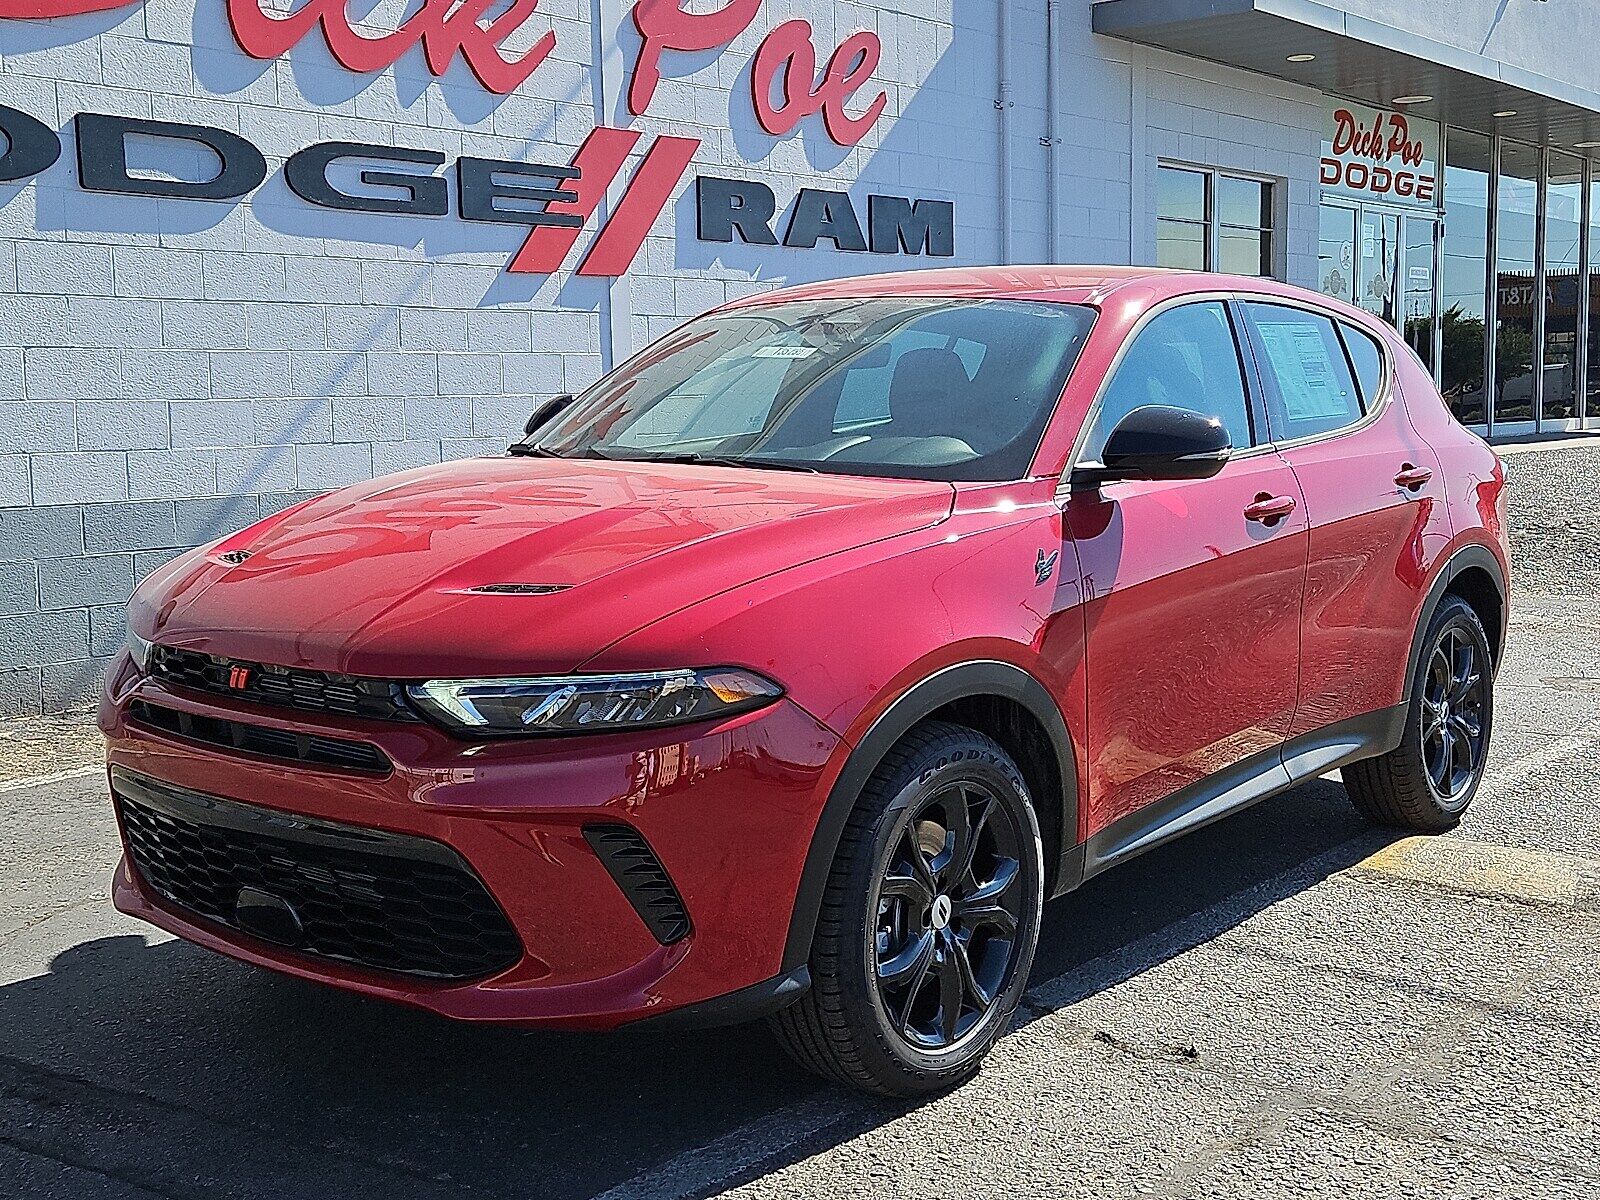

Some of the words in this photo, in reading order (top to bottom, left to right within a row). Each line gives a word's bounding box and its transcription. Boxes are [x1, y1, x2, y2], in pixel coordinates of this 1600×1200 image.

[1333, 109, 1384, 161] Dick
[1386, 114, 1424, 167] Poe
[1320, 157, 1435, 201] DODGE
[695, 175, 955, 257] RAM
[918, 749, 1031, 809] GOODYEAR
